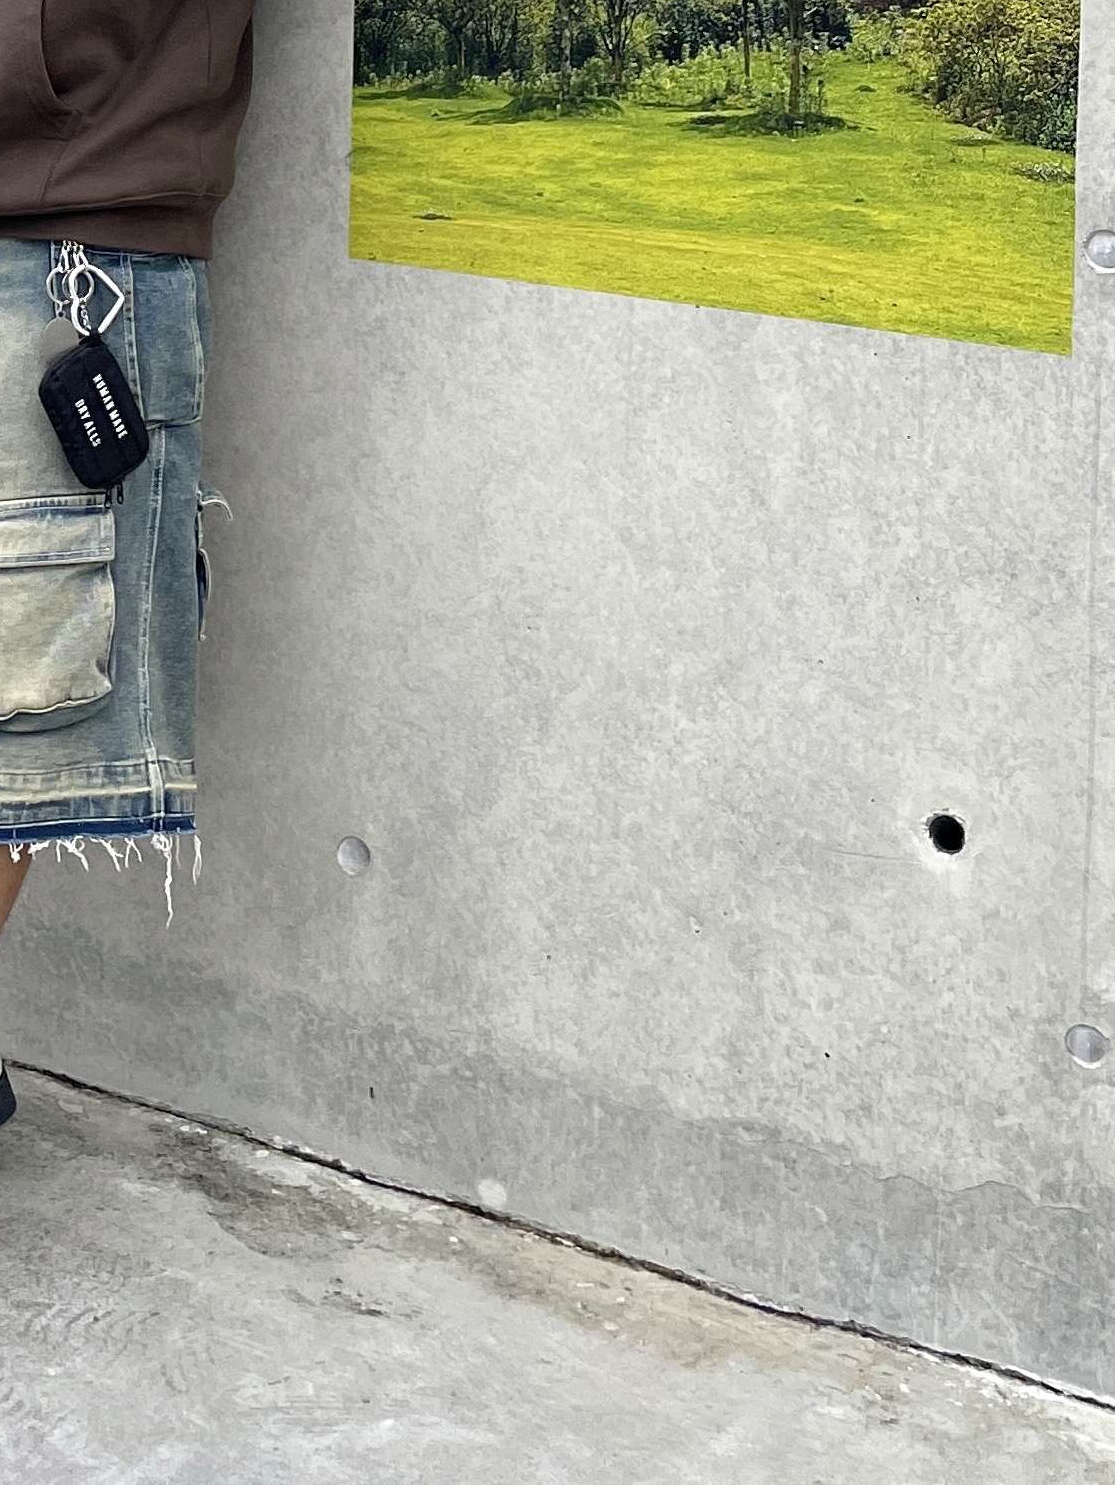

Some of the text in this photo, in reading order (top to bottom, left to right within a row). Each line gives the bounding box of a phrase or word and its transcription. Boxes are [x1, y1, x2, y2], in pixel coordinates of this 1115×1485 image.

[74, 398, 102, 447] DRY ALLS
[92, 373, 128, 439] HUMAN MADE
